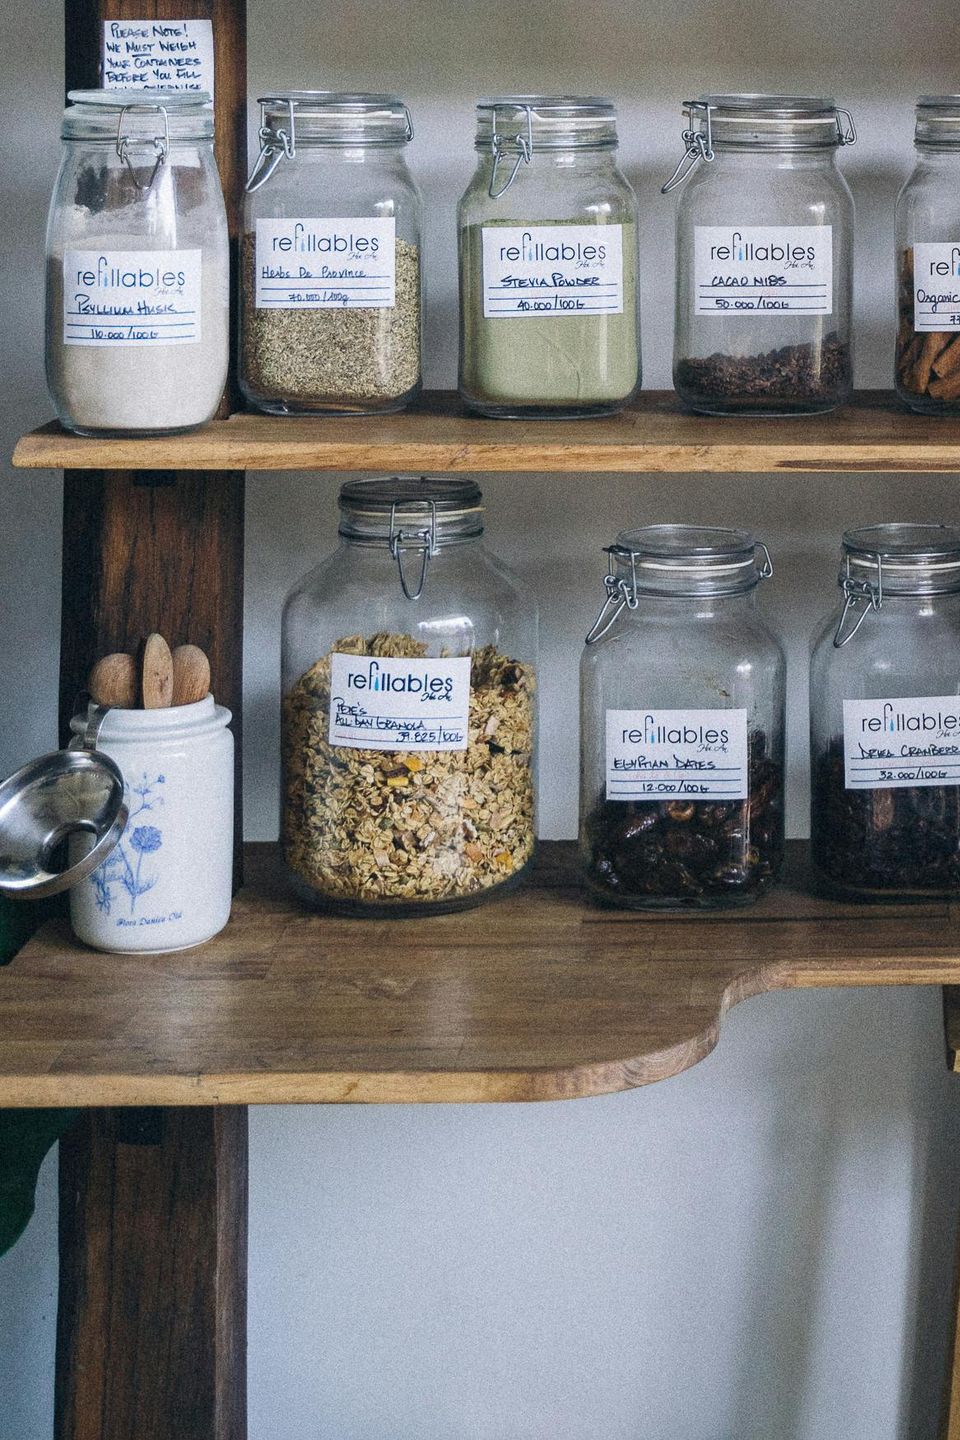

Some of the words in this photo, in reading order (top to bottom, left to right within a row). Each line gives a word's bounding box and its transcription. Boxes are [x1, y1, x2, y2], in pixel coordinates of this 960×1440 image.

[110, 22, 150, 39] PLEASE
[106, 41, 121, 53] WE
[126, 41, 155, 53] MUST
[159, 40, 197, 52] WEIGH
[107, 57, 131, 69] YOUR
[135, 57, 202, 69] CONTAINERS
[105, 71, 149, 83] BEFORE
[153, 68, 171, 80] YOU
[176, 68, 202, 79] FILL
[273, 223, 380, 252] refillables
[500, 232, 607, 261] refillables
[711, 232, 816, 261] refillables
[77, 256, 186, 288] refillables
[262, 266, 290, 278] Herbs
[300, 266, 312, 278] De
[500, 275, 549, 288] STEVIA
[551, 273, 600, 288] POWDER
[711, 276, 749, 287] CACAO
[753, 275, 788, 287] NIBS
[917, 289, 960, 314] Organic
[348, 661, 453, 693] refillables
[376, 716, 426, 731] GRANOLA
[622, 715, 729, 745] refillables
[672, 754, 717, 770] DATES
